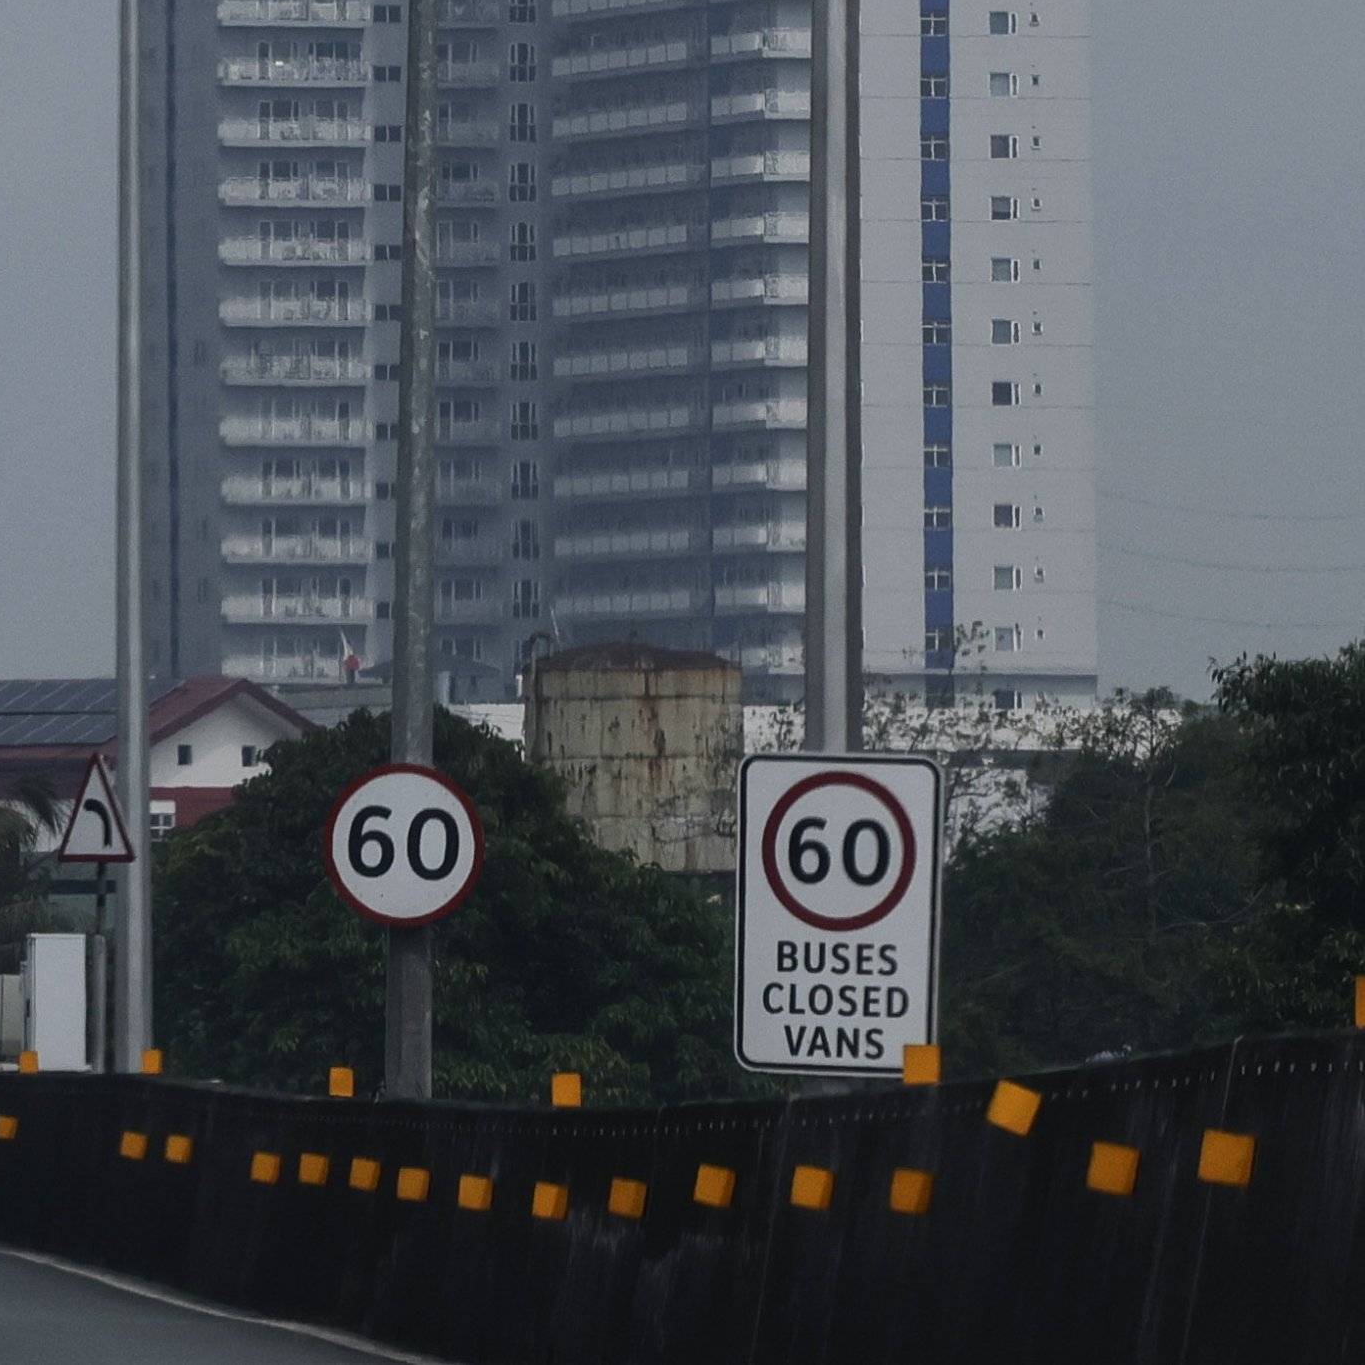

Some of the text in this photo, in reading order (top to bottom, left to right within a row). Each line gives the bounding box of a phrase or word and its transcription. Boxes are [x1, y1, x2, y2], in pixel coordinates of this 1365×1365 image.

[347, 805, 460, 881] 60
[788, 816, 891, 887] 60
[776, 940, 898, 977] BUSES
[762, 981, 909, 1019] CLOSED
[783, 1024, 885, 1061] VANS
